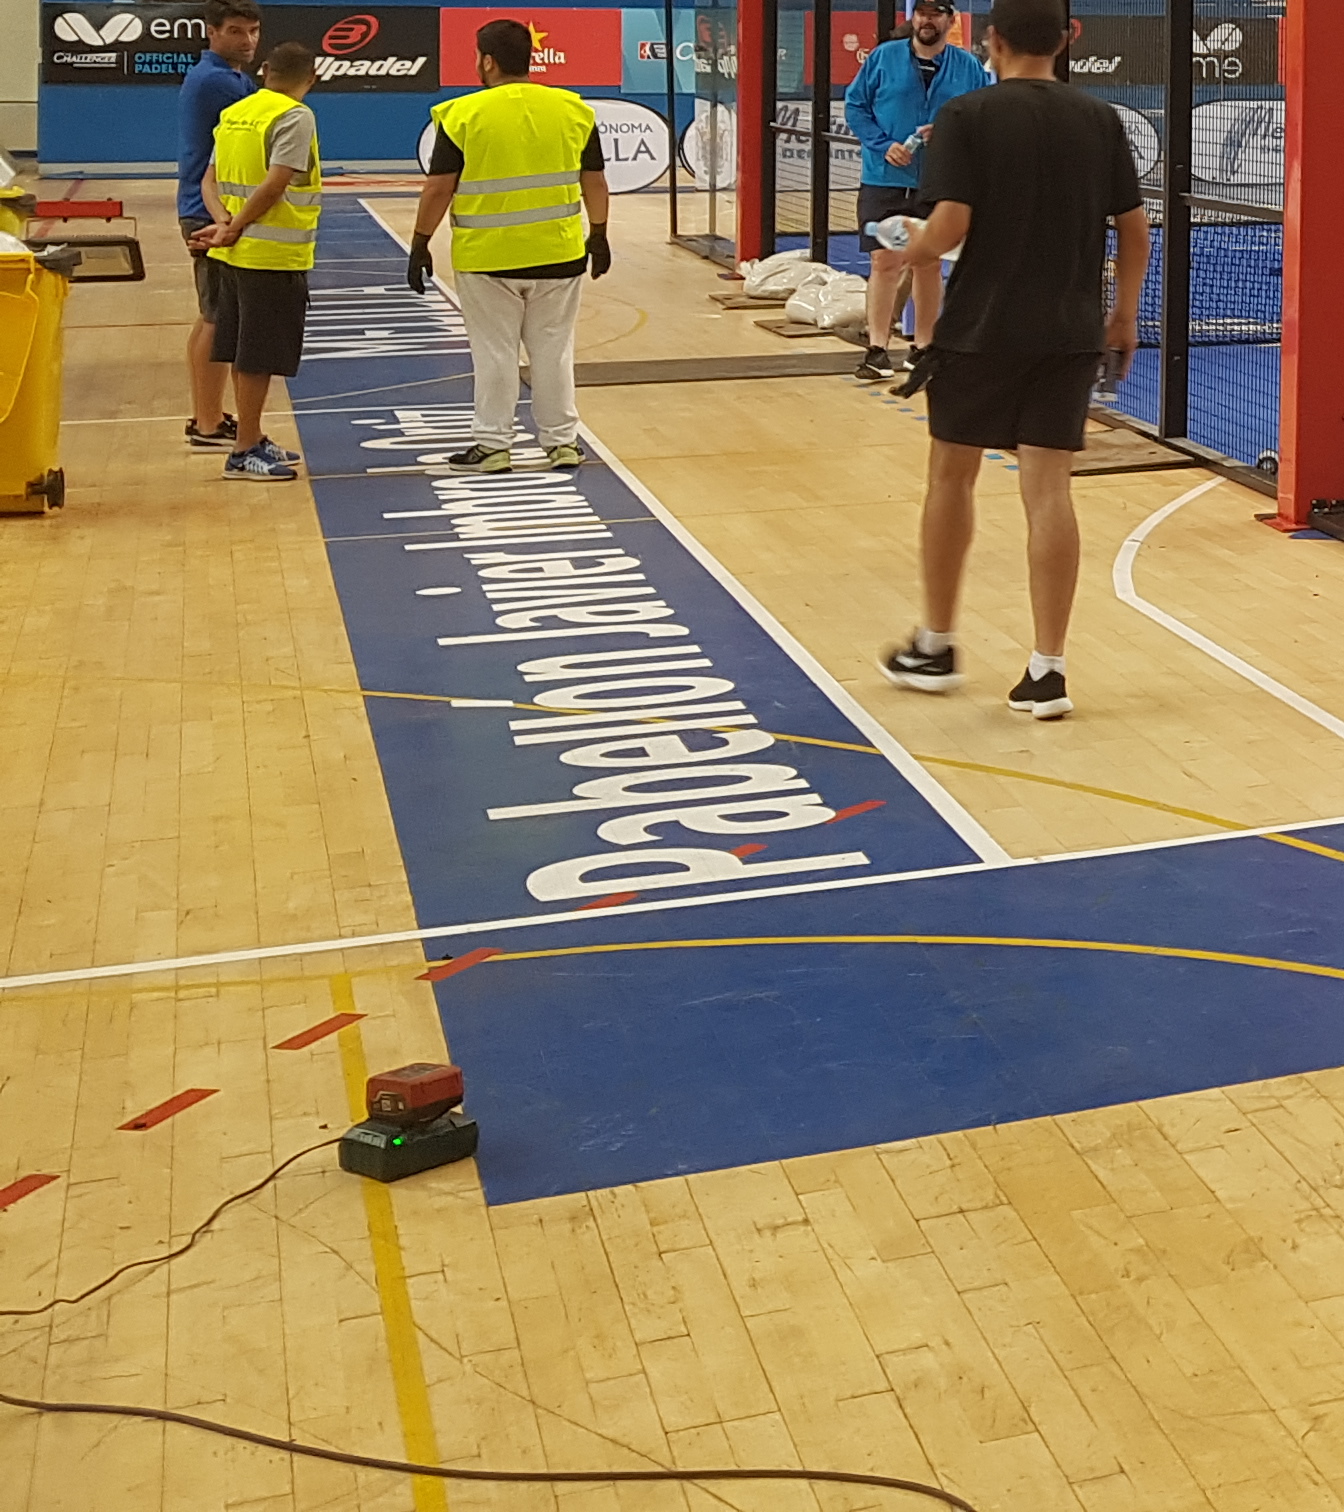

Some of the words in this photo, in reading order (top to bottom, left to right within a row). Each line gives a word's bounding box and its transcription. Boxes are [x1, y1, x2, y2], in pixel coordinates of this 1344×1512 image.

[150, 17, 206, 39] em
[134, 53, 194, 64] OFFICIAL
[529, 47, 566, 65] rella
[134, 63, 175, 74] PADEL
[598, 120, 653, 134] ÓNOMA
[413, 547, 691, 647] Javier
[450, 644, 872, 903] Pabellón
